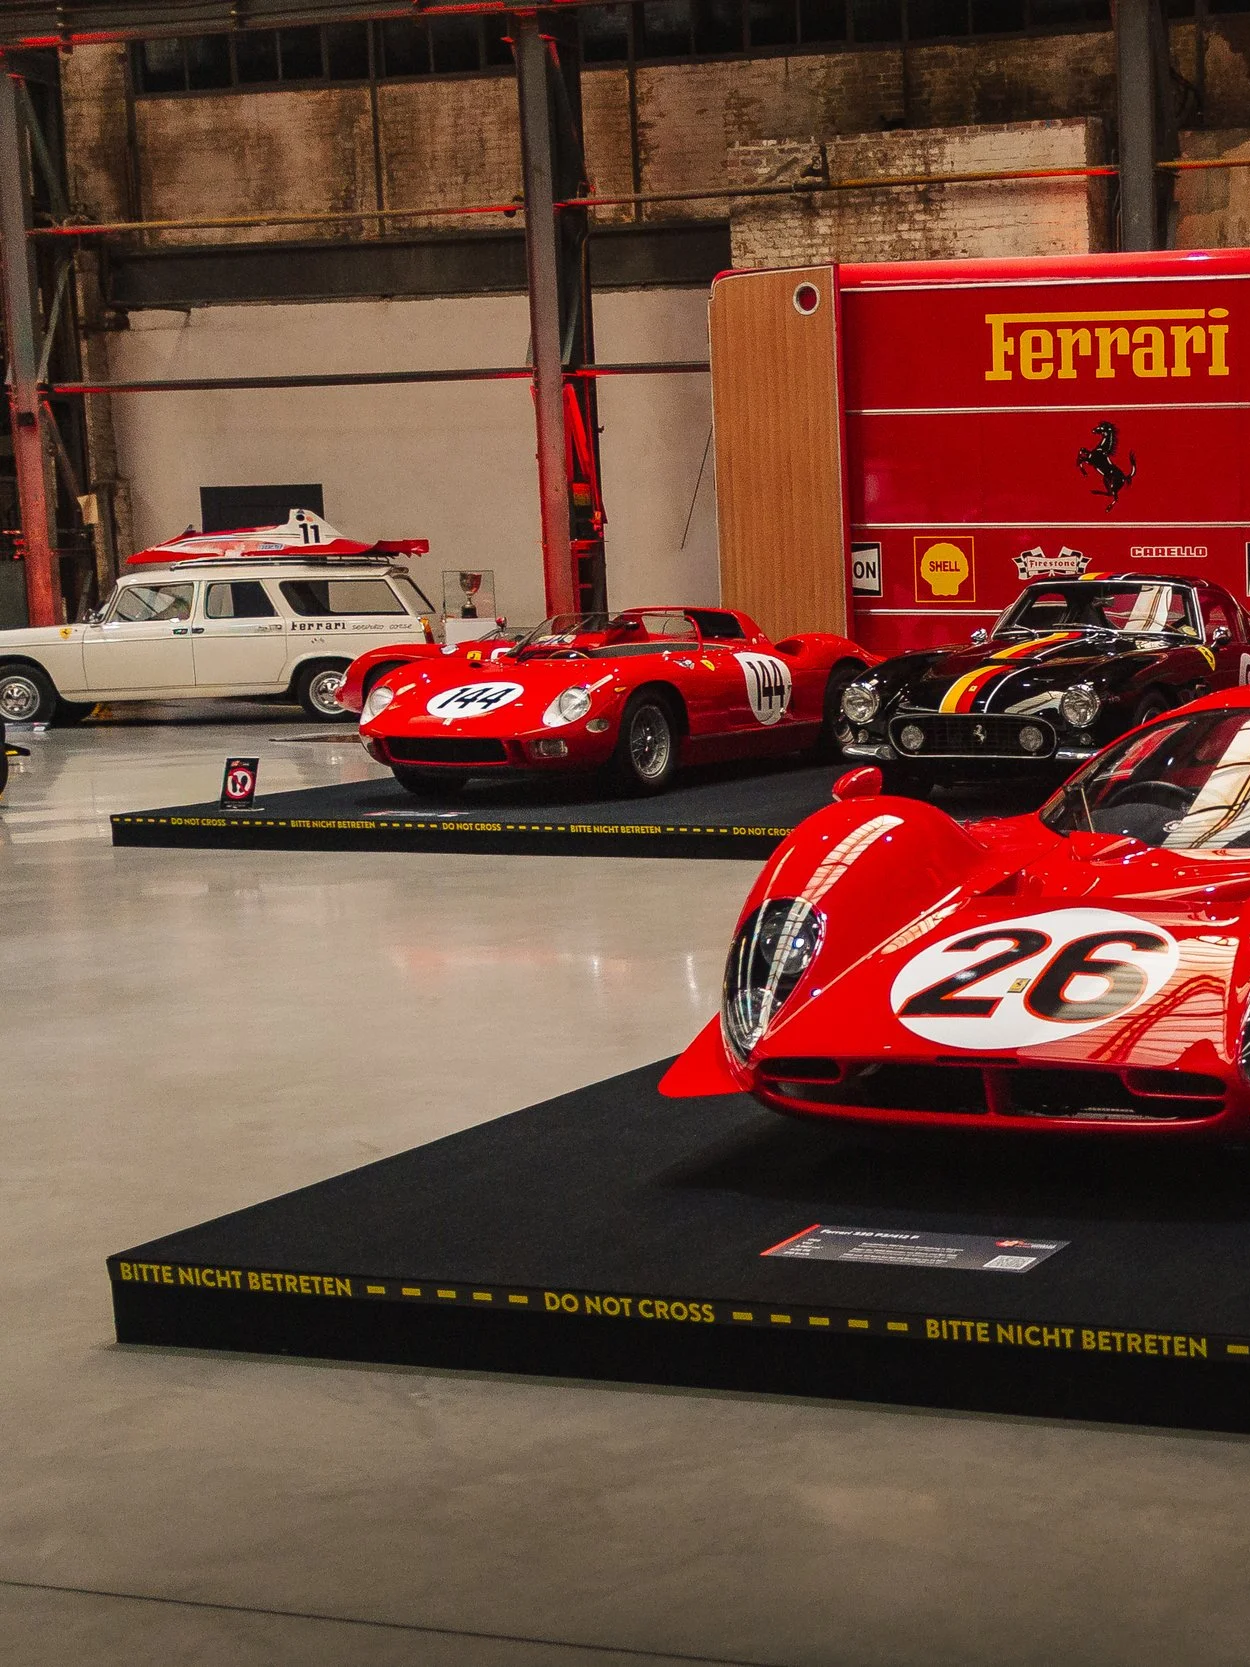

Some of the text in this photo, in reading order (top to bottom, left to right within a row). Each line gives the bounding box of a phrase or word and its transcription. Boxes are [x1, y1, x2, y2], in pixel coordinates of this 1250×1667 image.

[984, 307, 1230, 382] Ferrari
[299, 523, 320, 544] 11
[1130, 546, 1208, 558] CARELLO
[929, 561, 960, 572] SHELL
[1029, 559, 1076, 569] Firestone
[290, 621, 346, 631] Ferrari
[748, 660, 785, 711] 144
[437, 684, 518, 710] 144
[171, 817, 226, 827] DO NOT CROSS
[290, 820, 375, 829] BITTE NICHT BETRETEN
[442, 822, 501, 832] DO NOT CROSS
[593, 825, 619, 833] NICHT
[620, 826, 661, 835] BETRETEN
[733, 827, 746, 835] DO
[748, 827, 766, 836] NOT
[895, 928, 1170, 1024] 26
[120, 1262, 352, 1296] BITTE NICHT BETRETEN
[544, 1291, 715, 1323] DO NOT CROSS
[925, 1318, 1208, 1358] BITTE NICHT BETRETEN
